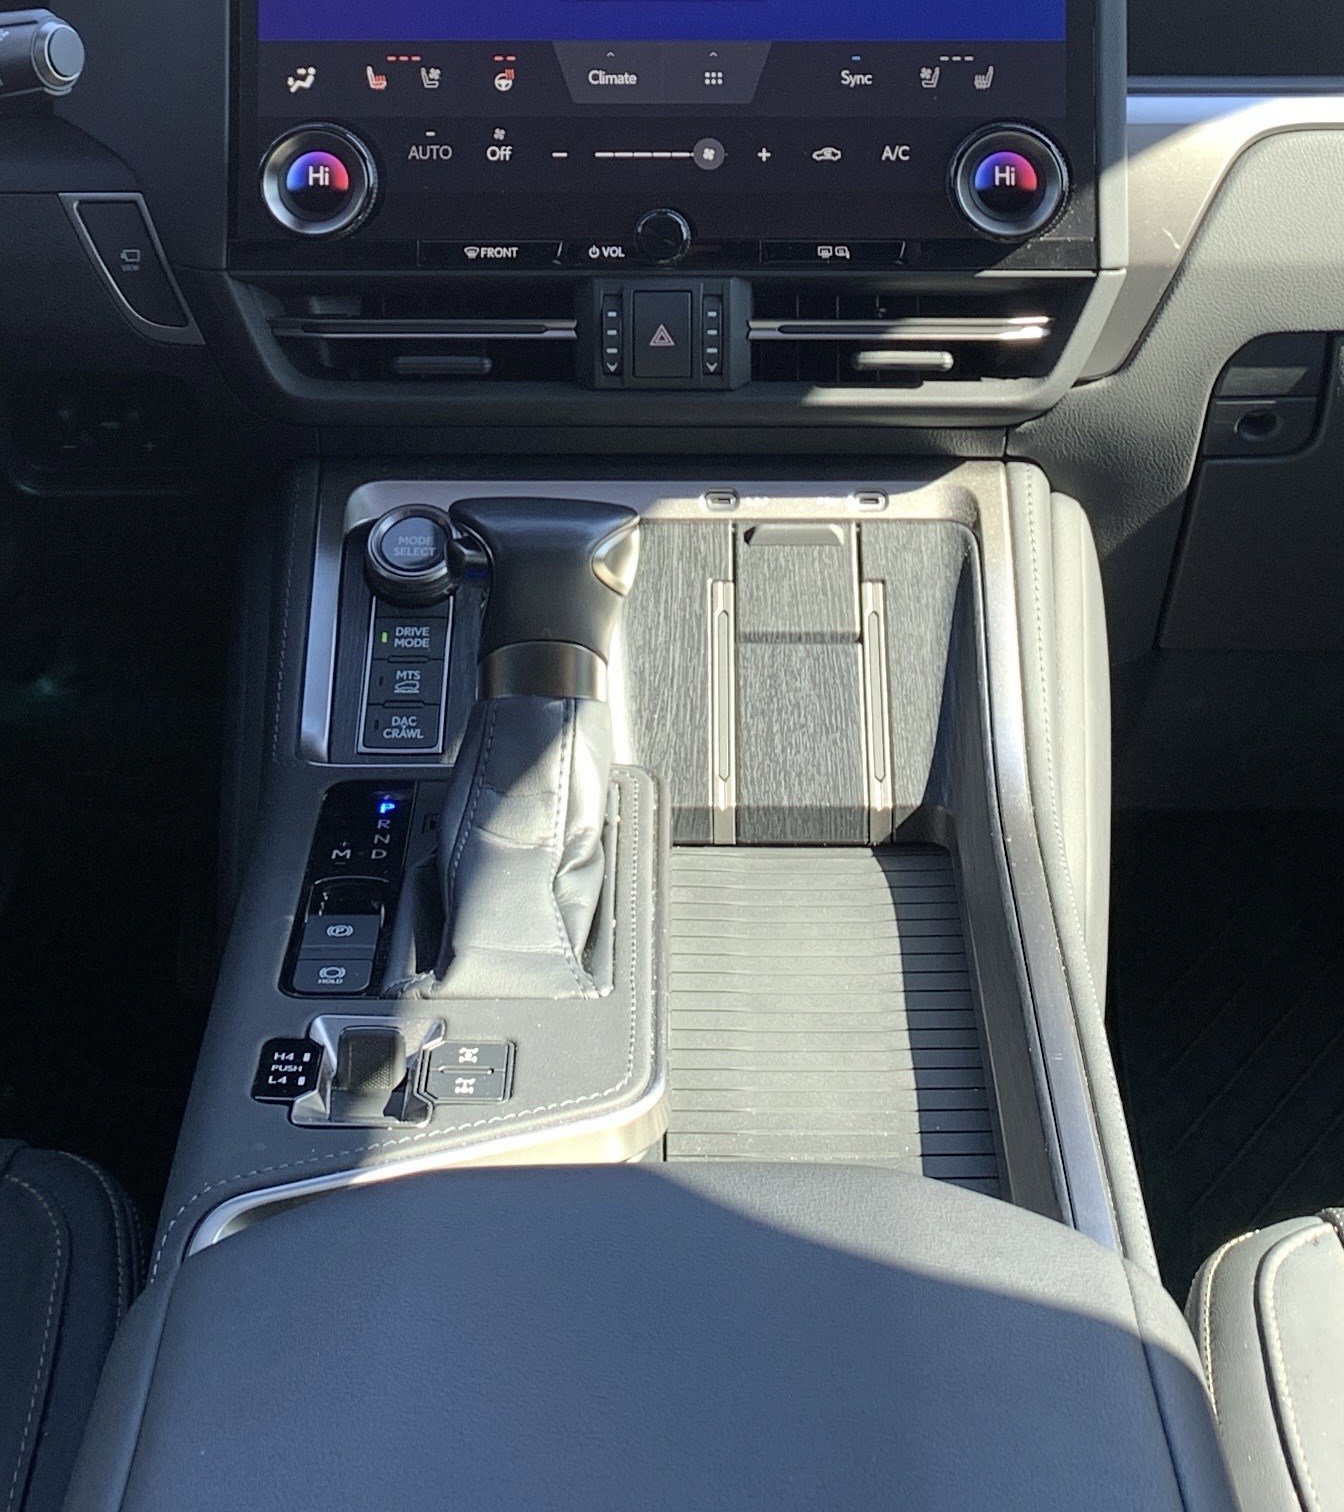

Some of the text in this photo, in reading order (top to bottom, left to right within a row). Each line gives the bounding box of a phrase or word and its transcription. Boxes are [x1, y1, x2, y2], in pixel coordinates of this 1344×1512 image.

[587, 70, 638, 86] Climate
[839, 70, 874, 89] Sync
[408, 144, 453, 161] AUTO
[486, 144, 513, 161] Off
[881, 144, 911, 163] A/C
[307, 164, 331, 187] Hi
[994, 164, 1017, 187] Hi
[479, 246, 519, 260] FRONT
[600, 246, 626, 259] VOL
[398, 536, 435, 546] MODE
[393, 546, 436, 557] SELECT
[395, 626, 431, 638] DRIVE
[393, 638, 430, 649] MODE
[395, 670, 421, 681] MTS
[391, 715, 418, 727] DAC
[382, 728, 425, 740] CRAWL
[379, 802, 396, 814] P
[376, 818, 391, 830] R
[373, 834, 391, 844] N
[331, 848, 352, 860] M
[370, 848, 388, 860] D
[273, 1052, 295, 1061] H4
[270, 1064, 303, 1073] PUSH
[267, 1075, 287, 1085] L4
